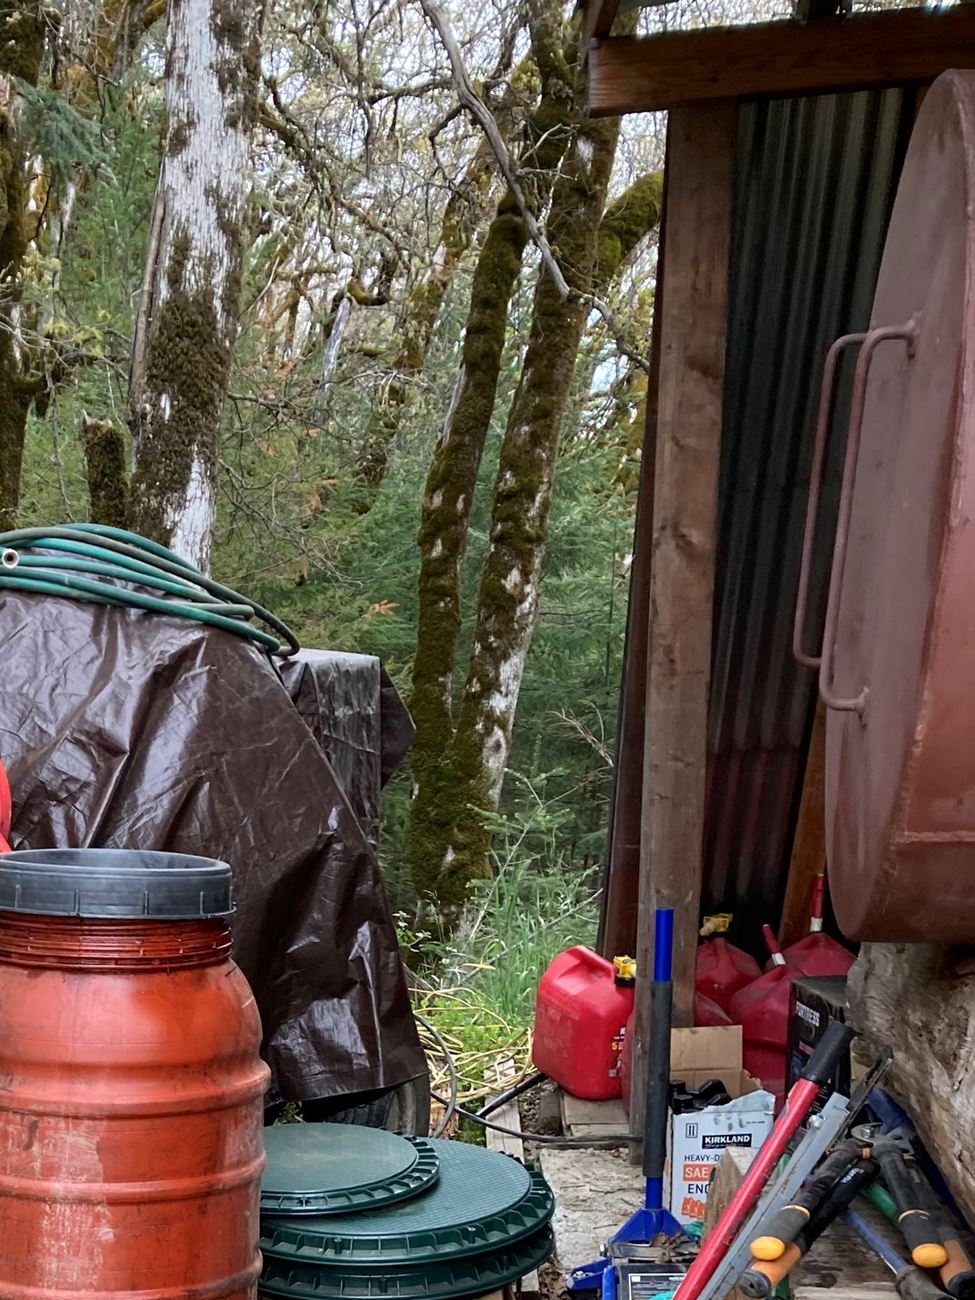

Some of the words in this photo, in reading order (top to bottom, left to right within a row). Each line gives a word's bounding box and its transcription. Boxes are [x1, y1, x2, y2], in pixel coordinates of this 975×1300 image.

[704, 1135, 751, 1144] KIRKLAND
[684, 1154, 721, 1162] HEAVY-D
[685, 1167, 709, 1179] SAE
